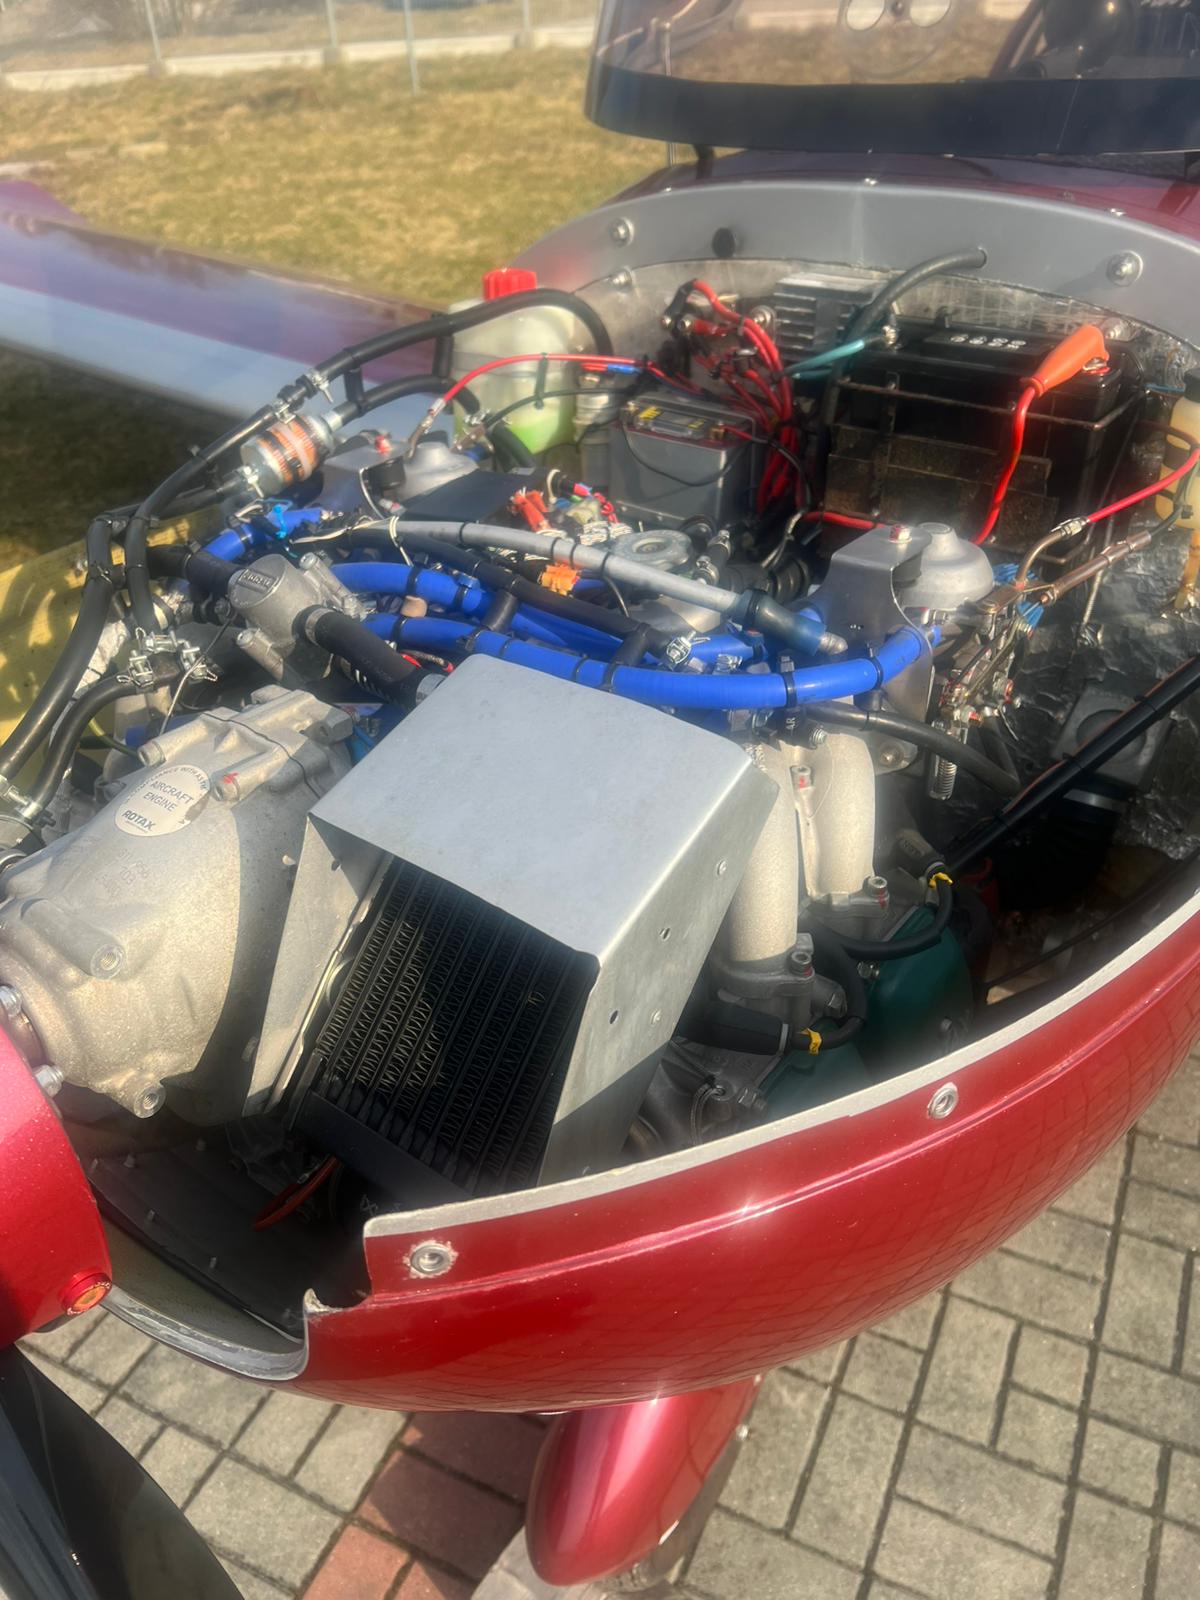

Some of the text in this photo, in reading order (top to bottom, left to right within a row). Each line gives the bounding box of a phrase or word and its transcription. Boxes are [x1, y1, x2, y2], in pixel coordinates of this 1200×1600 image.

[143, 792, 177, 812] ENGINE
[151, 780, 194, 805] AIRCRAFT
[122, 810, 156, 830] ROTAX
